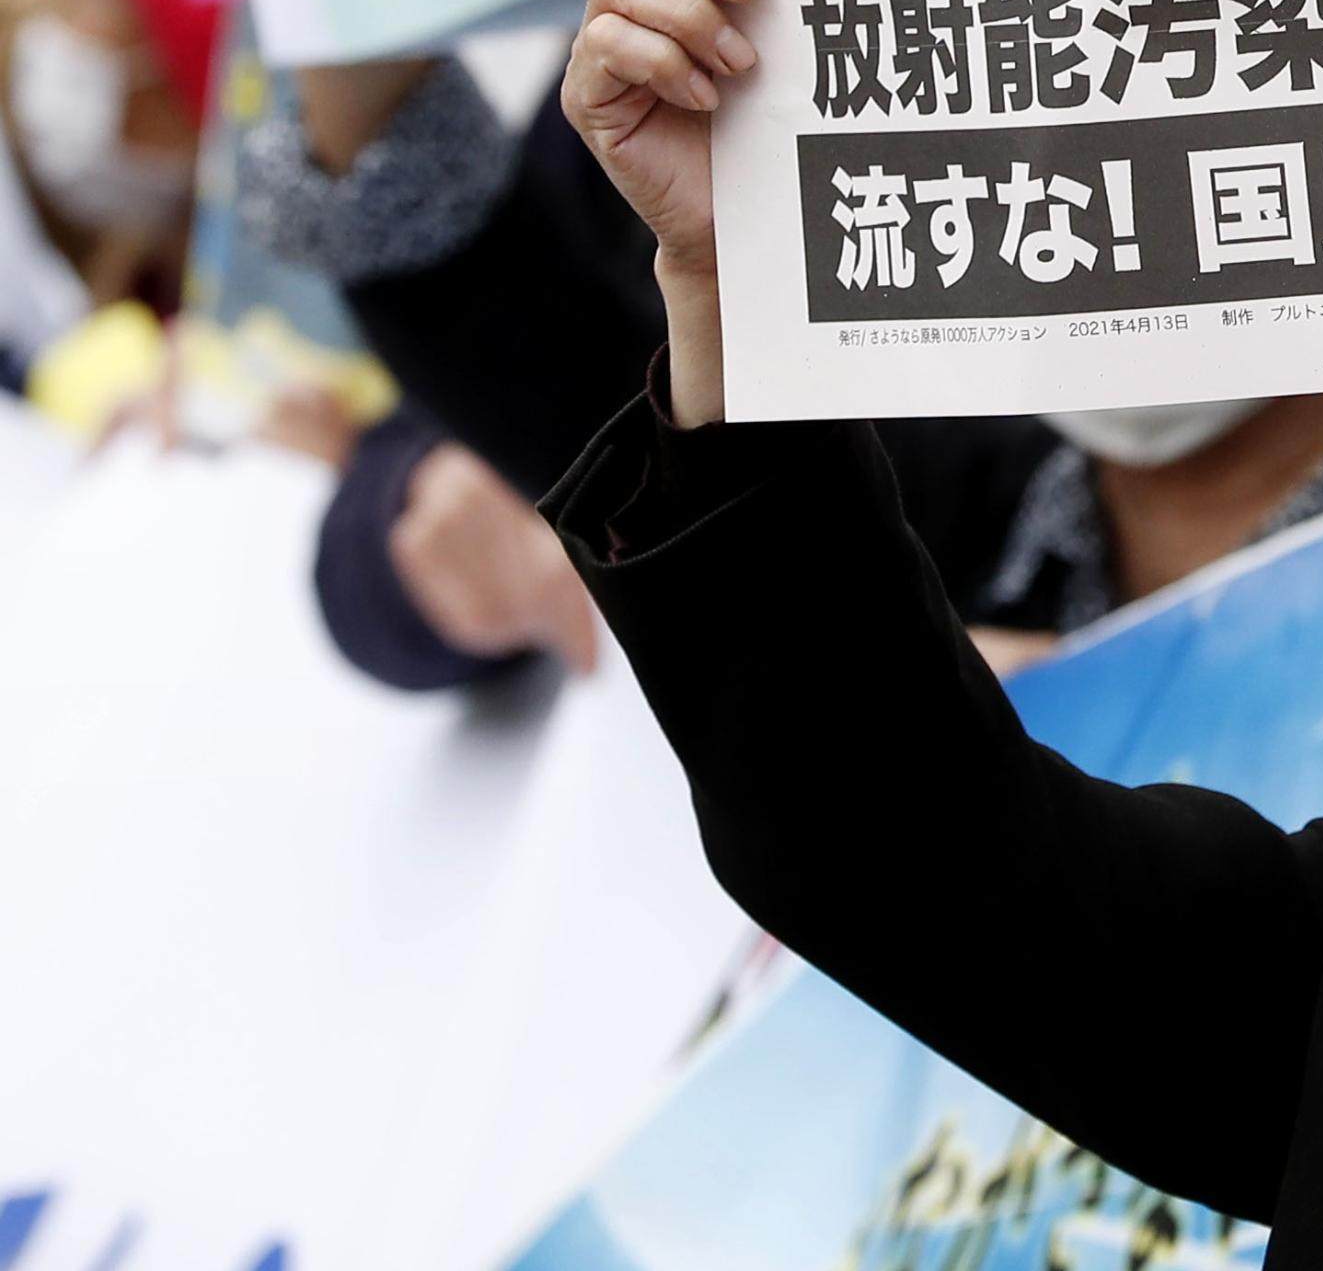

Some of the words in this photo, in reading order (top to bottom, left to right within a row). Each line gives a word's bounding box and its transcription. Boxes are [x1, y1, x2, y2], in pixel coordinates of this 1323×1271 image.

[830, 159, 1142, 291] 流すな!
[1068, 314, 1189, 338] 2021年4月13日
[1221, 308, 1254, 326] 制作
